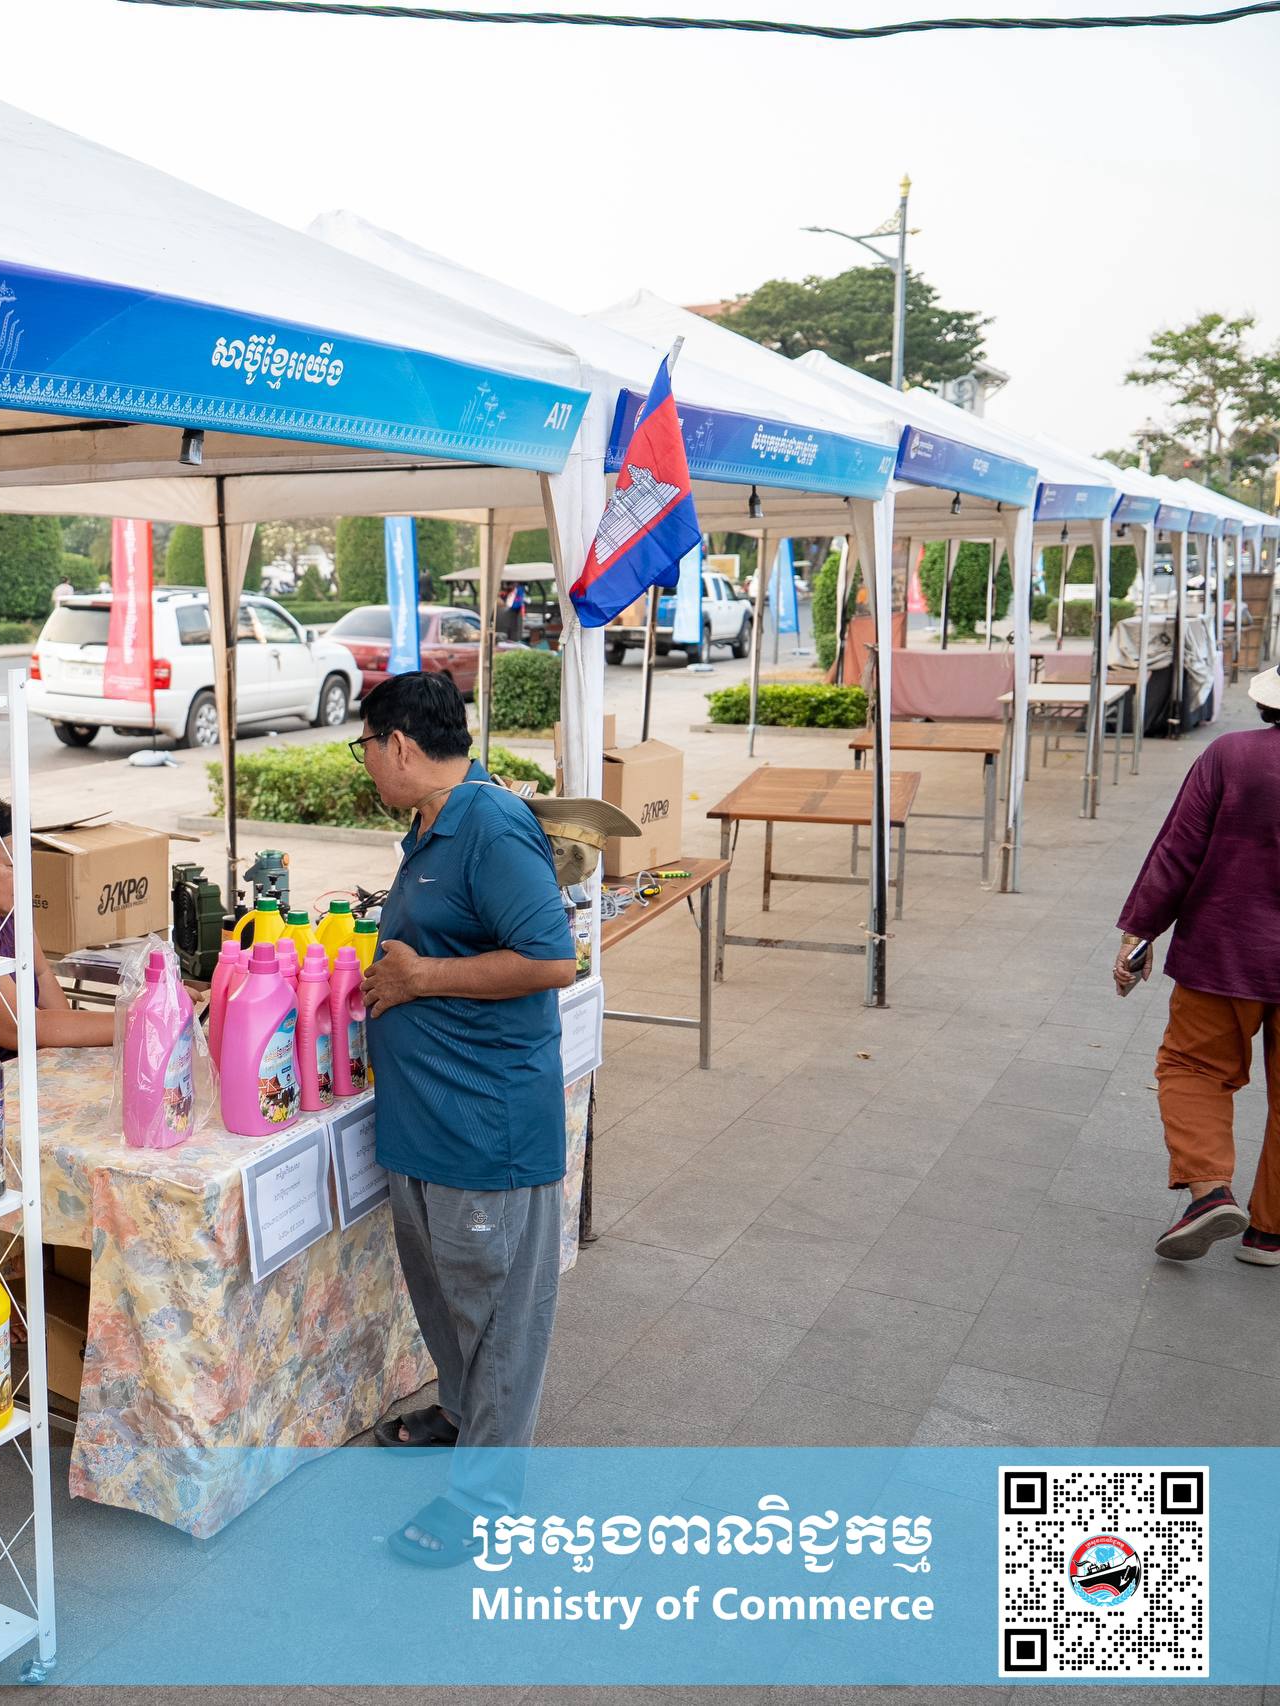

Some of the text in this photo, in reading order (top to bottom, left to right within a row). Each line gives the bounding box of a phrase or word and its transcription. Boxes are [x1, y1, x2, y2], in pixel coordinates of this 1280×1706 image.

[210, 333, 345, 390] សាប៊ូខ្មែរយើង
[543, 401, 573, 431] A11
[97, 876, 149, 916] KKPO
